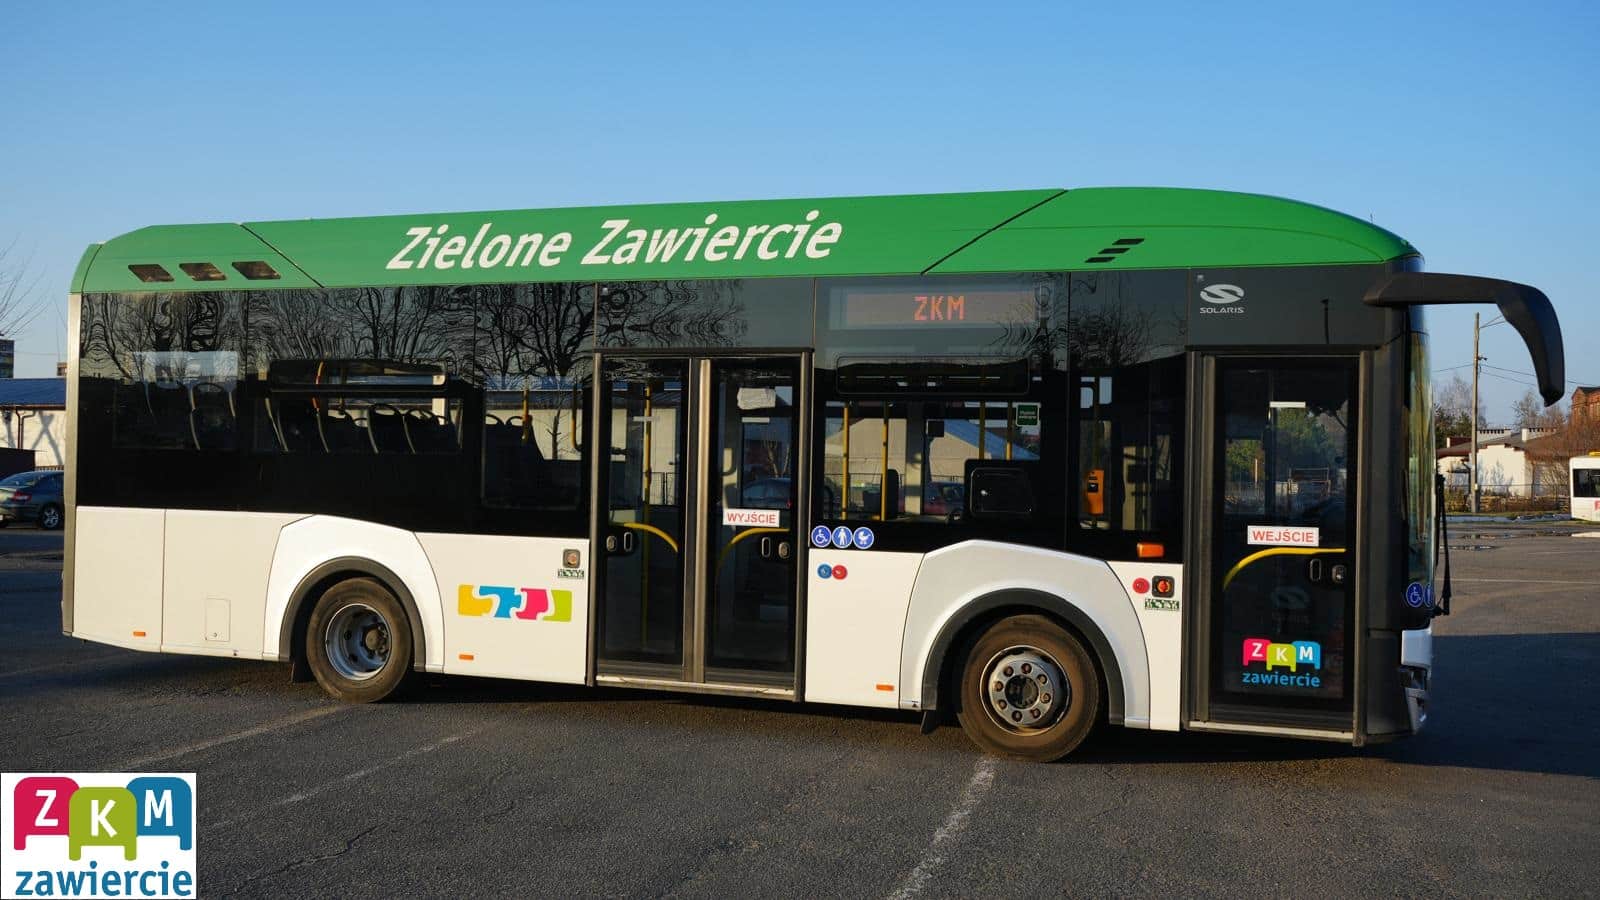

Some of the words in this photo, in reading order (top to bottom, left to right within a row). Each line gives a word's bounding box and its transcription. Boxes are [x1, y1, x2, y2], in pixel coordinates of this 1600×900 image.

[386, 222, 573, 270] Zielone
[581, 209, 843, 266] Zawiercie
[914, 295, 965, 321] ZKM
[727, 512, 777, 524] WYJŚCIE
[1252, 529, 1314, 542] WEJŚCIE
[1251, 642, 1314, 662] ZKM
[1242, 671, 1321, 687] zawiercie
